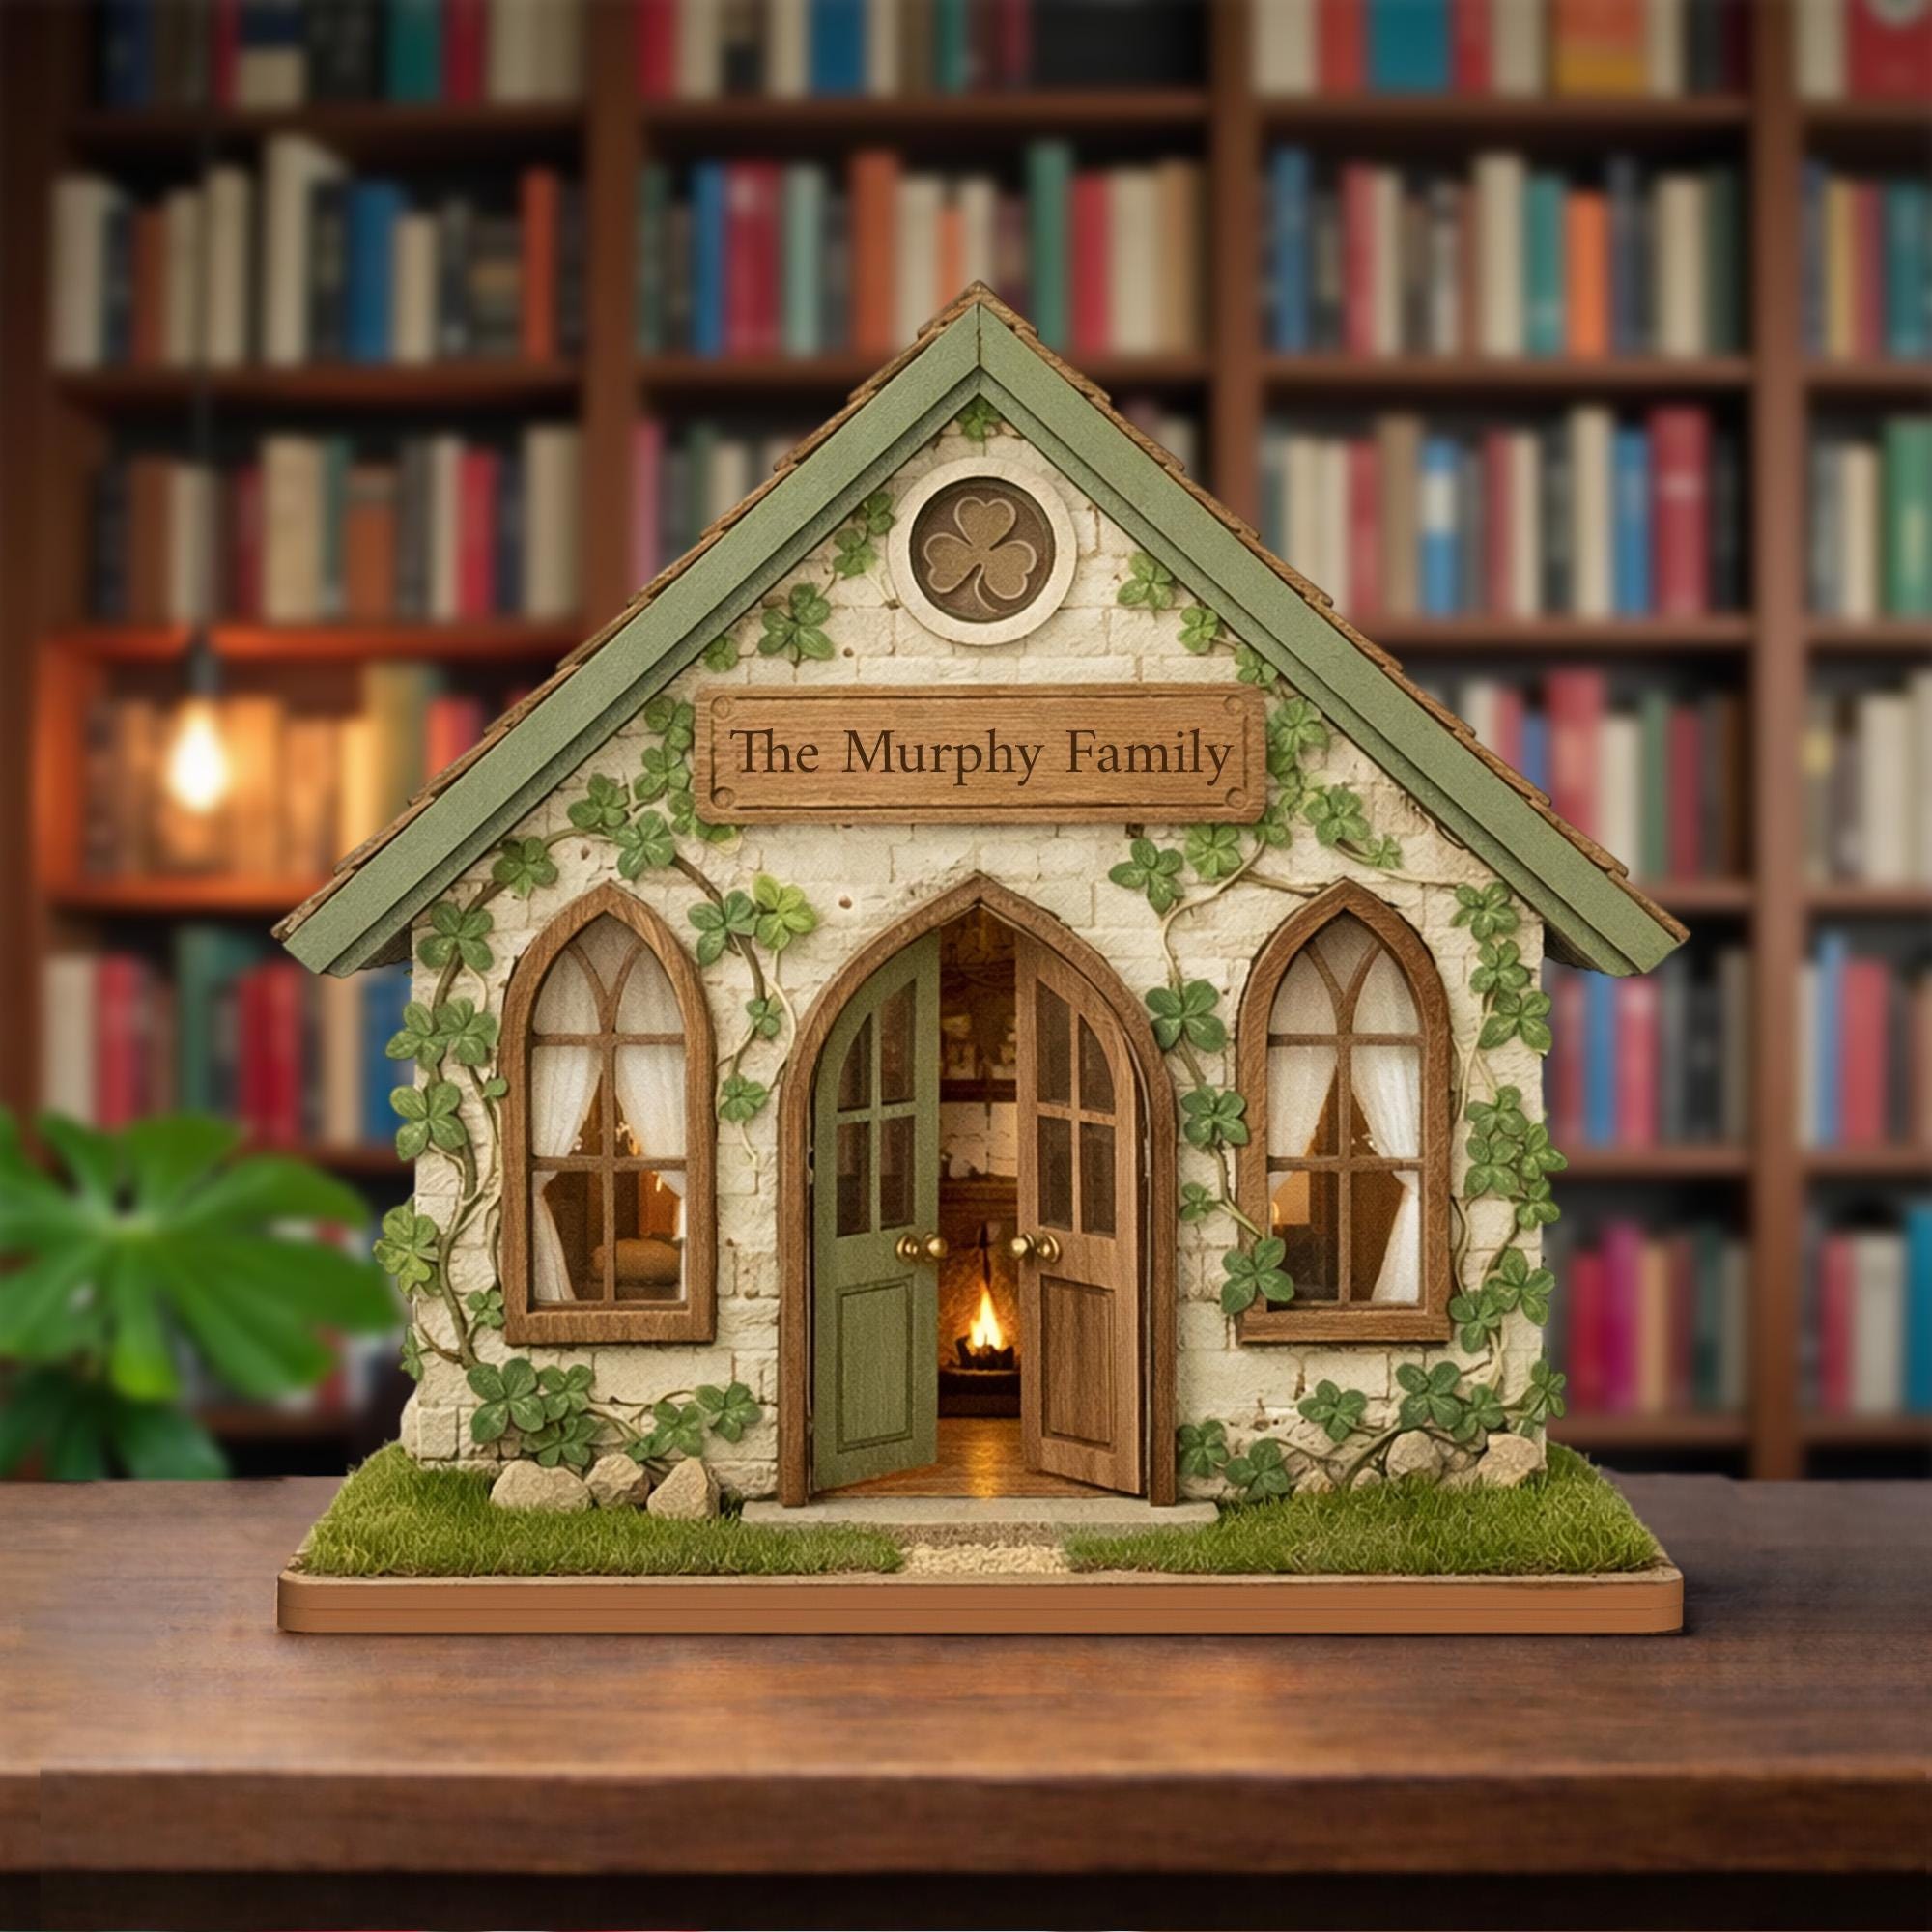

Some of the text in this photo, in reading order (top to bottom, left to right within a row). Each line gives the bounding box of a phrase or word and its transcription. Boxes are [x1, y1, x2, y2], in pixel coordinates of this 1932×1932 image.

[729, 727, 1235, 787] The Murphy Family
